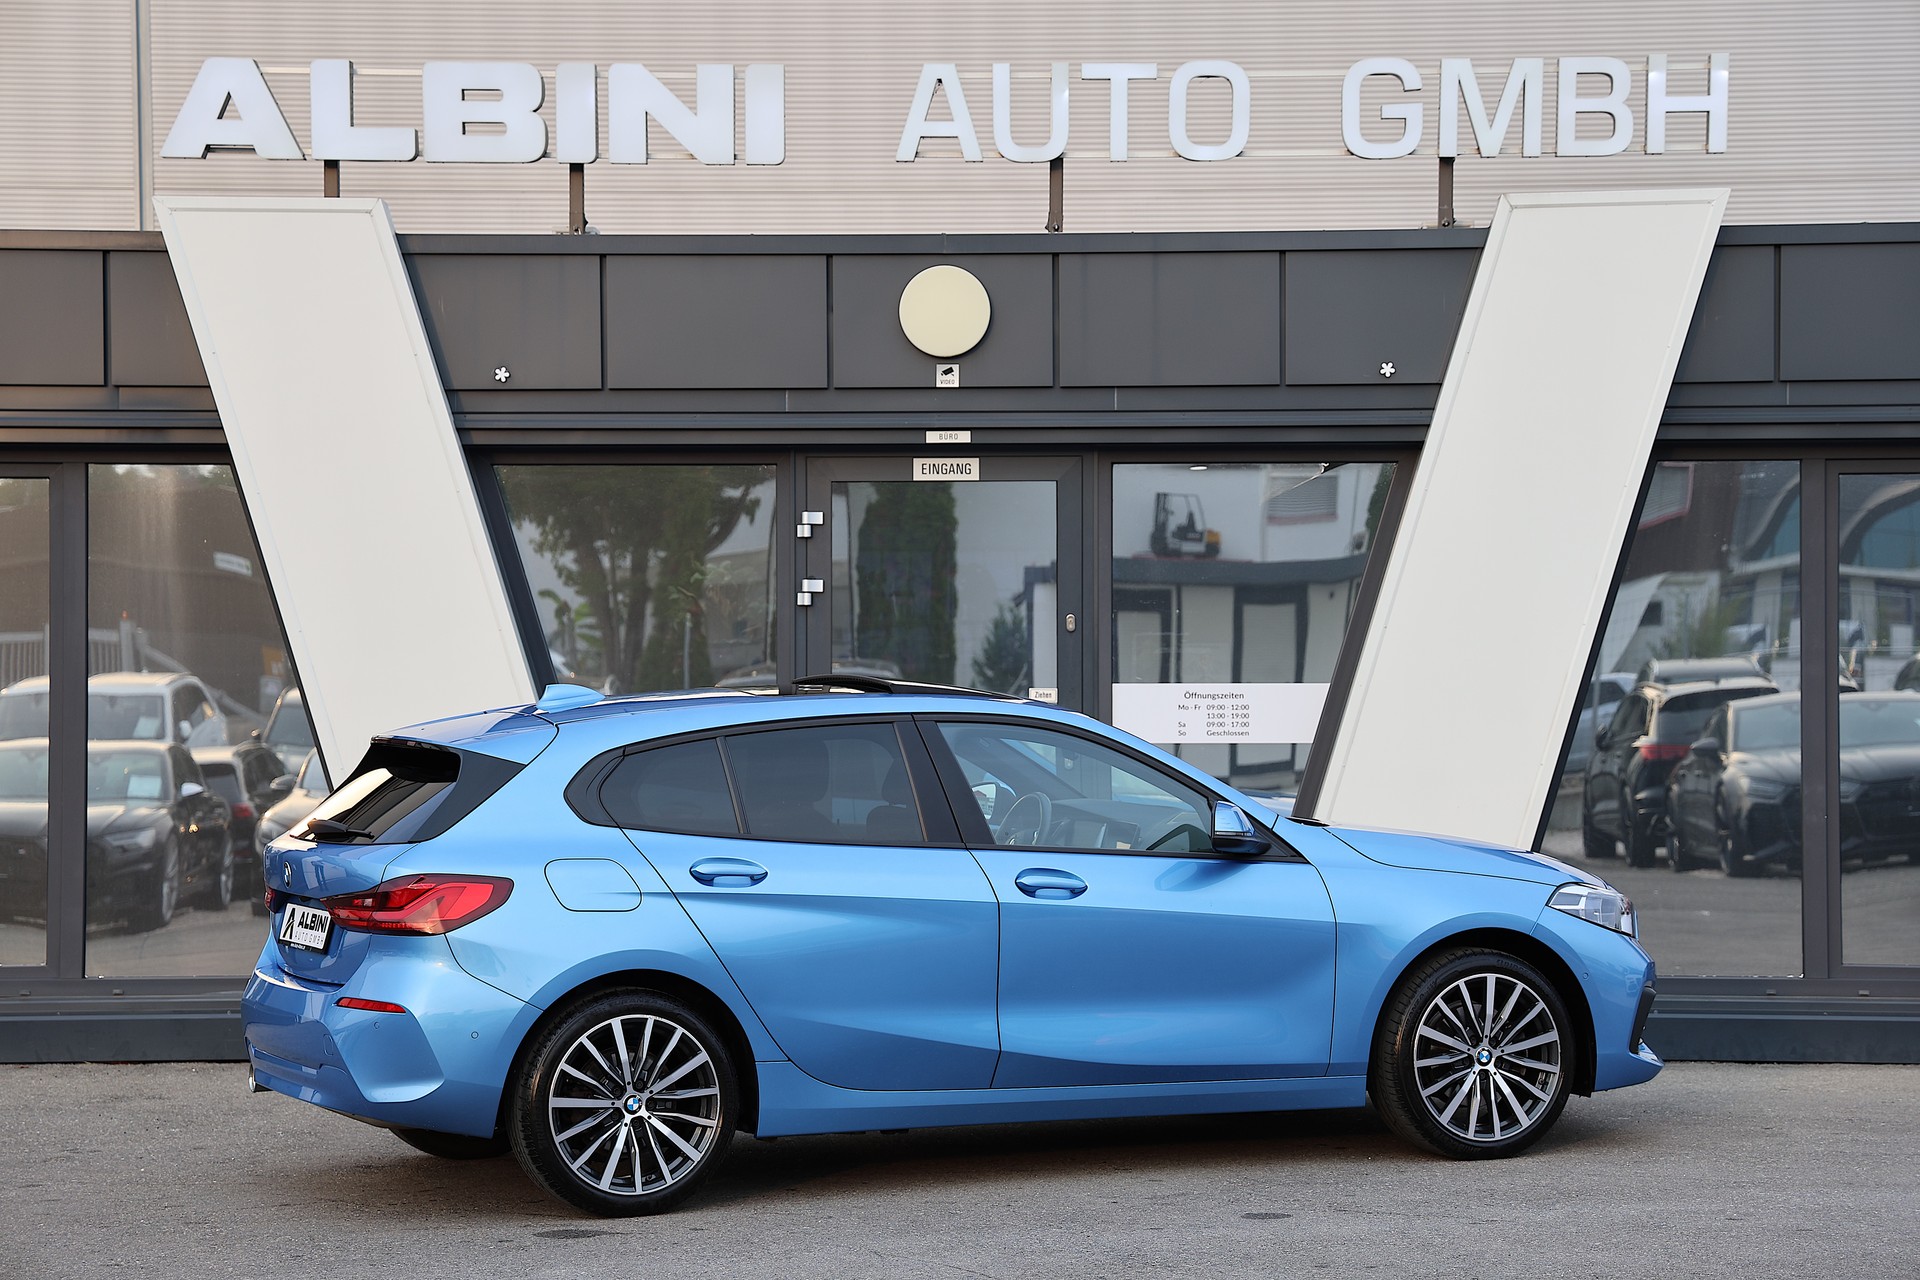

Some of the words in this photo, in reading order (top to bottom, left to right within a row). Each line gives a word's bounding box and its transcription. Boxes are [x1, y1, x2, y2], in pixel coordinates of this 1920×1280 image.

[159, 56, 786, 166] ALBINI
[896, 60, 1251, 163] AUTO
[1341, 53, 1730, 159] GMBH
[938, 432, 959, 440] BÜRO
[921, 463, 972, 475] EINGANG
[1184, 690, 1245, 700] Öffnungszeiten
[297, 911, 329, 934] ALBINI
